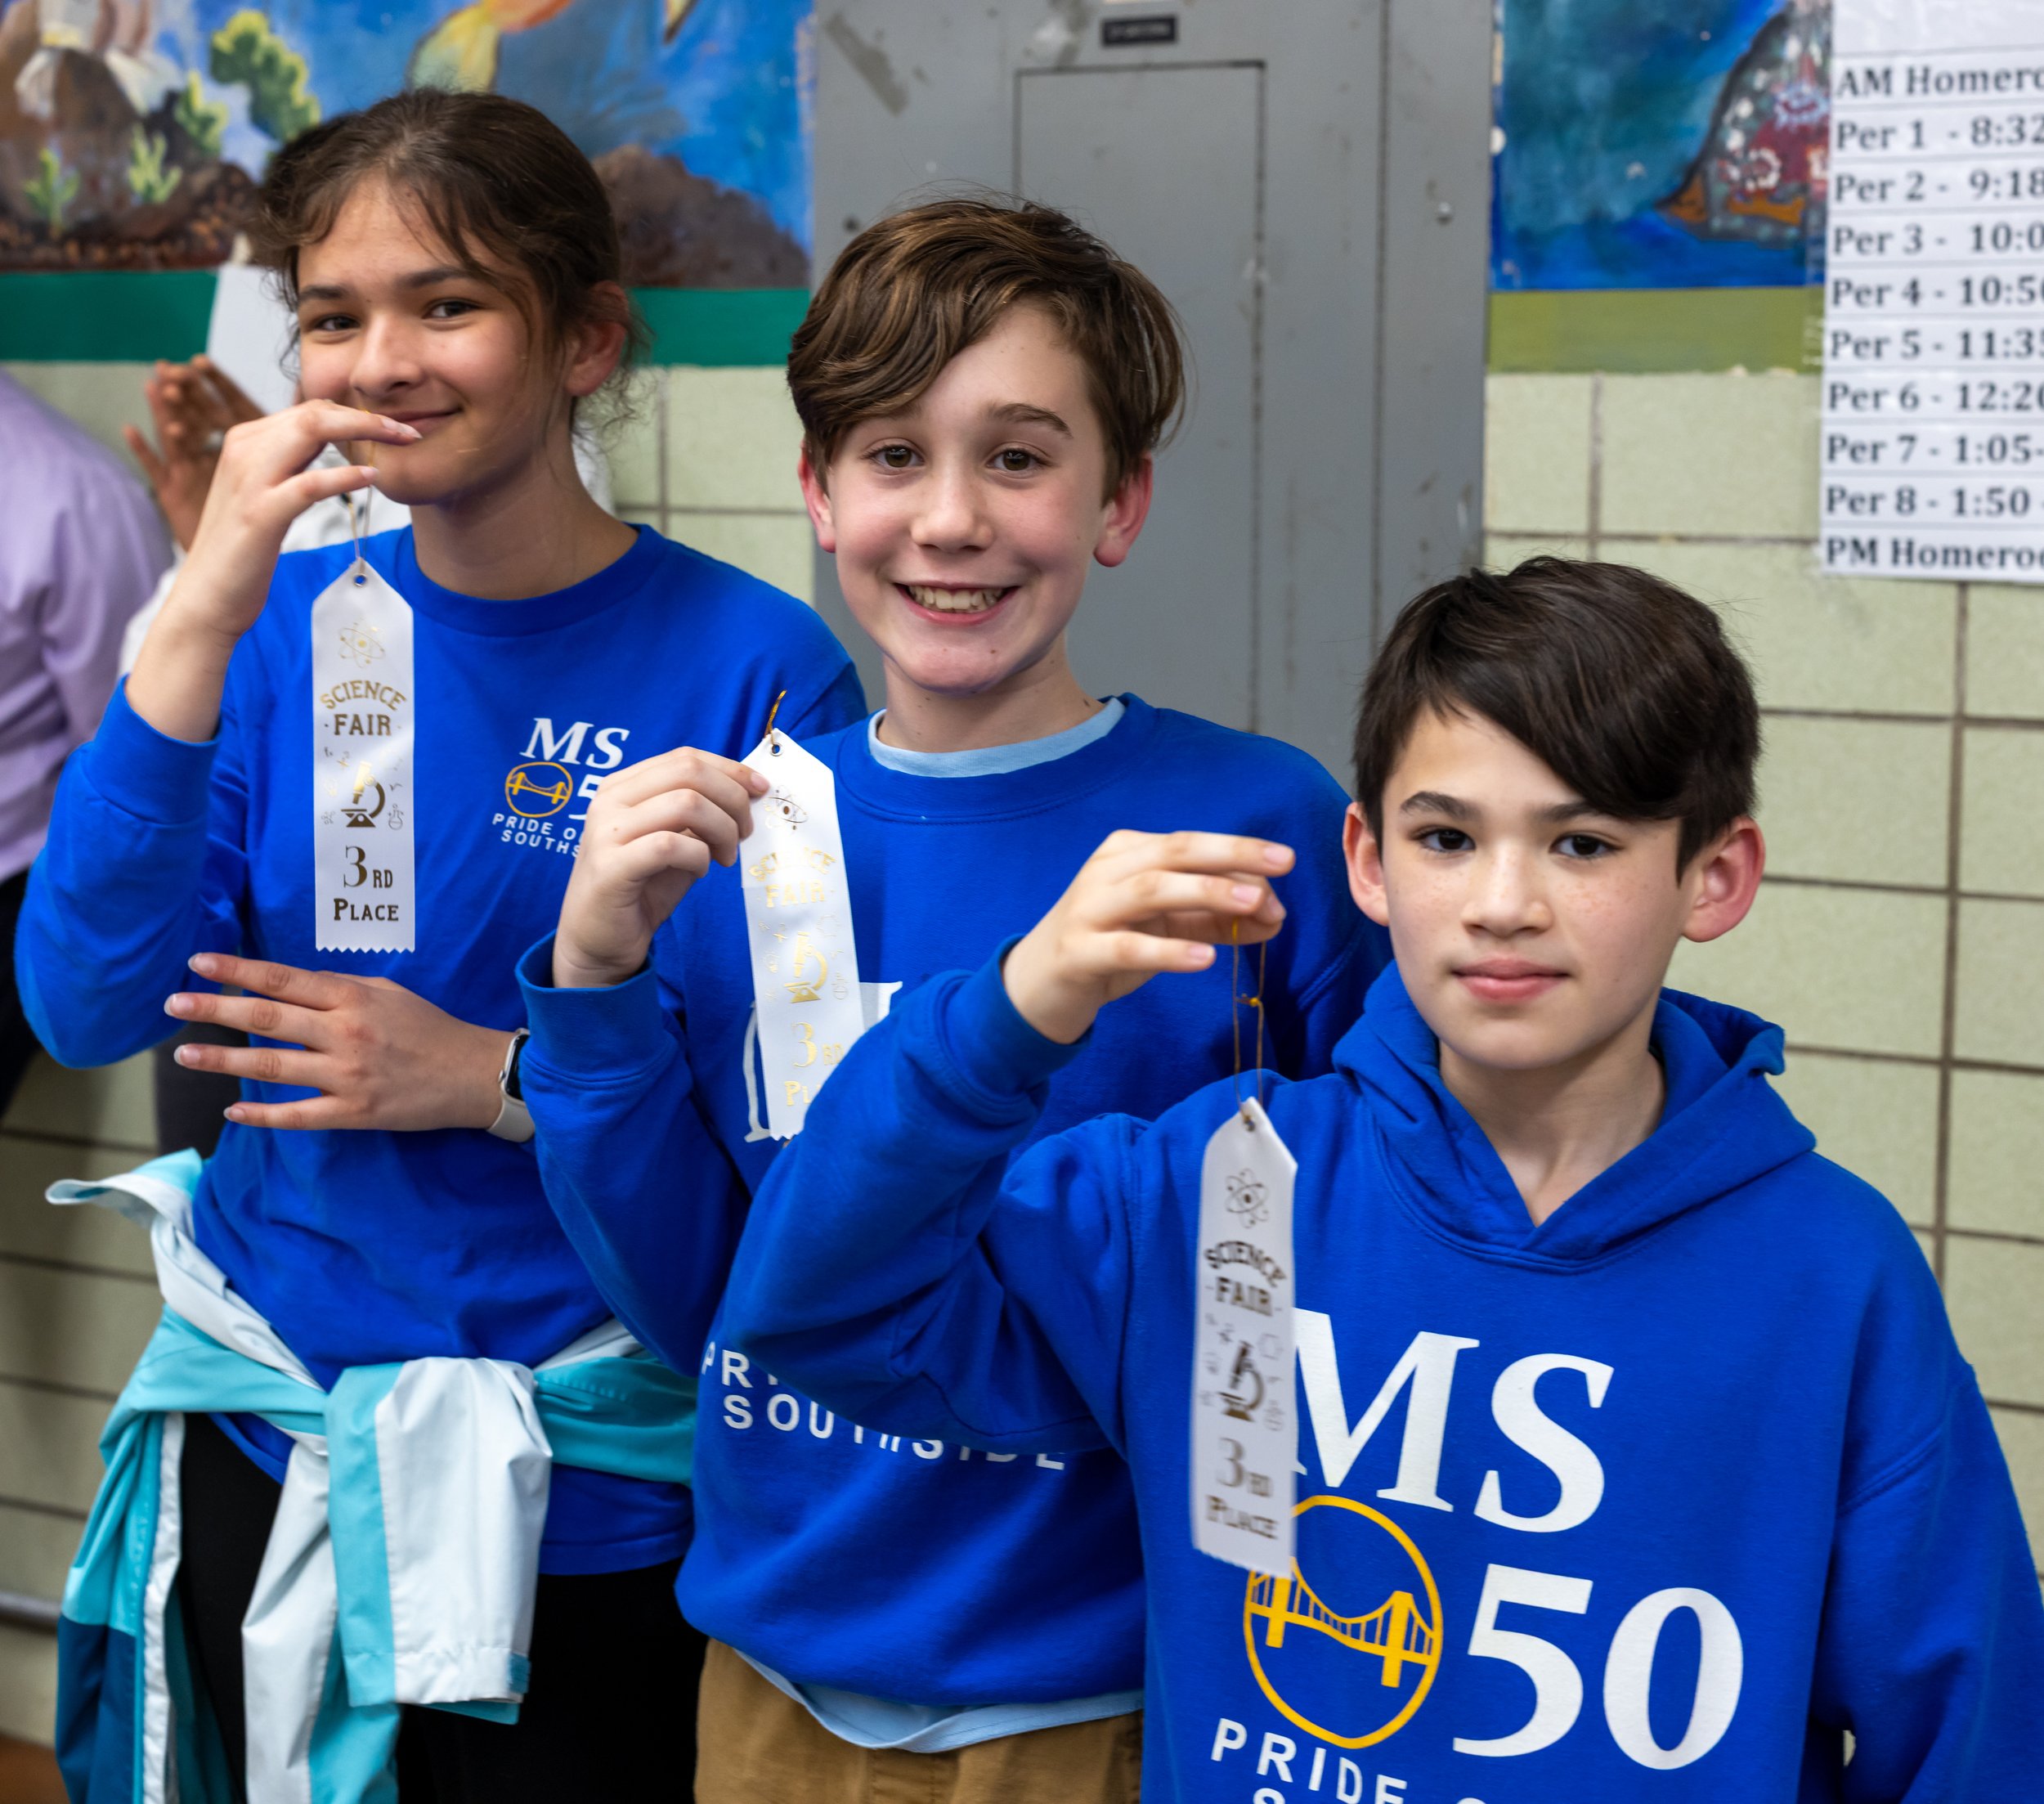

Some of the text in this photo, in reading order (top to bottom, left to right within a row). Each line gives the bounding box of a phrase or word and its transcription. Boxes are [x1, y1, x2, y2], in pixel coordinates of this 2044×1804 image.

[1836, 65, 1893, 97] AM
[1836, 119, 1896, 150] Per
[1909, 119, 1925, 149] 1
[1835, 173, 1894, 204] Per
[1906, 171, 1925, 202] 2
[1833, 226, 1894, 255] Per
[1903, 223, 1924, 254] 3
[1831, 278, 1892, 307] Per
[1901, 276, 1921, 306] 4
[1962, 275, 2044, 305] 10:5
[1831, 330, 1891, 360] Per
[1901, 330, 1921, 359] 5
[1829, 382, 1889, 411] Per
[1898, 381, 1920, 411] 6
[1827, 434, 1887, 464] Per
[1898, 434, 1917, 463] 7
[1826, 487, 1885, 515] Per
[1895, 486, 1917, 516] 8
[1954, 487, 2031, 518] 1:50
[1827, 537, 2044, 569] PM Homero
[320, 680, 407, 711] SCIENCE
[334, 713, 392, 737] FAIR
[519, 717, 630, 770] MS
[492, 813, 554, 836] PRIDE
[500, 829, 581, 858] SOUTHS
[343, 845, 393, 888] 3RD
[765, 879, 827, 909] FAIR
[334, 898, 400, 922] PLACE
[1293, 1306, 1615, 1533] MS
[1453, 1564, 1744, 1771] 50
